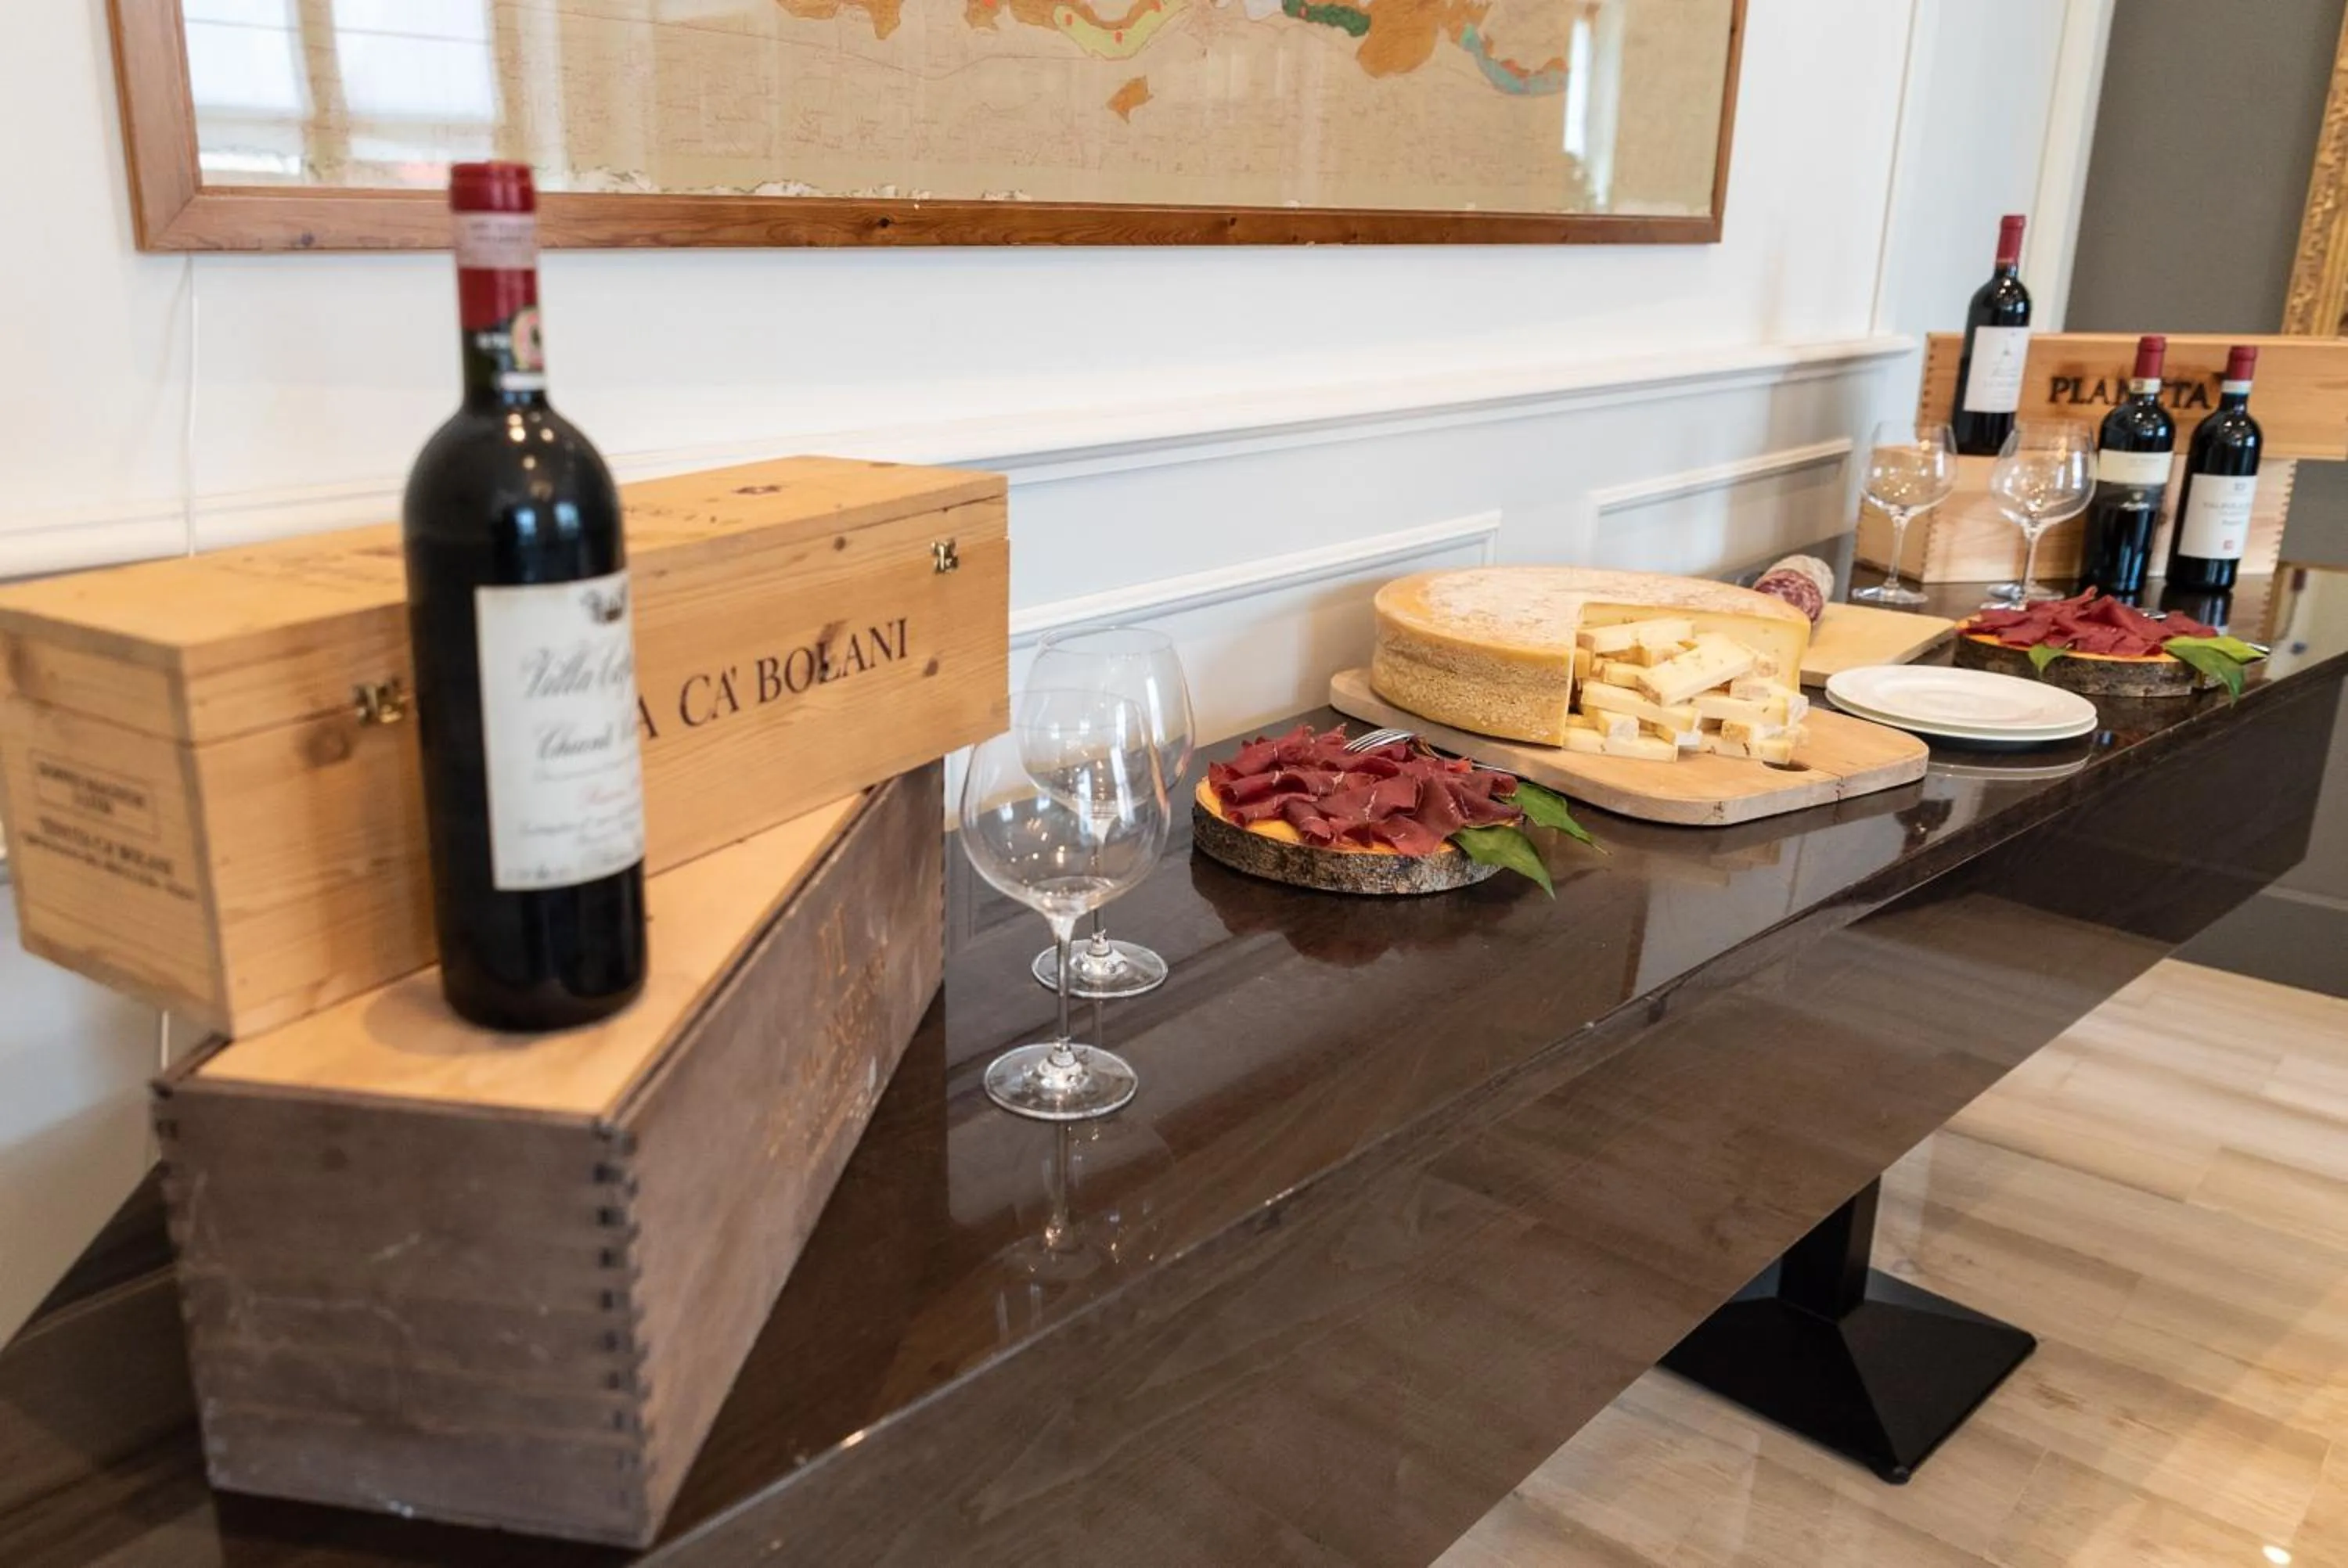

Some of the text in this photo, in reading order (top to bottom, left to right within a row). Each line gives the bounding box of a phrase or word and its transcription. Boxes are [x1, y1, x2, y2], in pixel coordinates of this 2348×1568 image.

[2047, 376, 2211, 409] PLANTA
[679, 666, 740, 728] CA'
[755, 617, 909, 704] BOLANI
